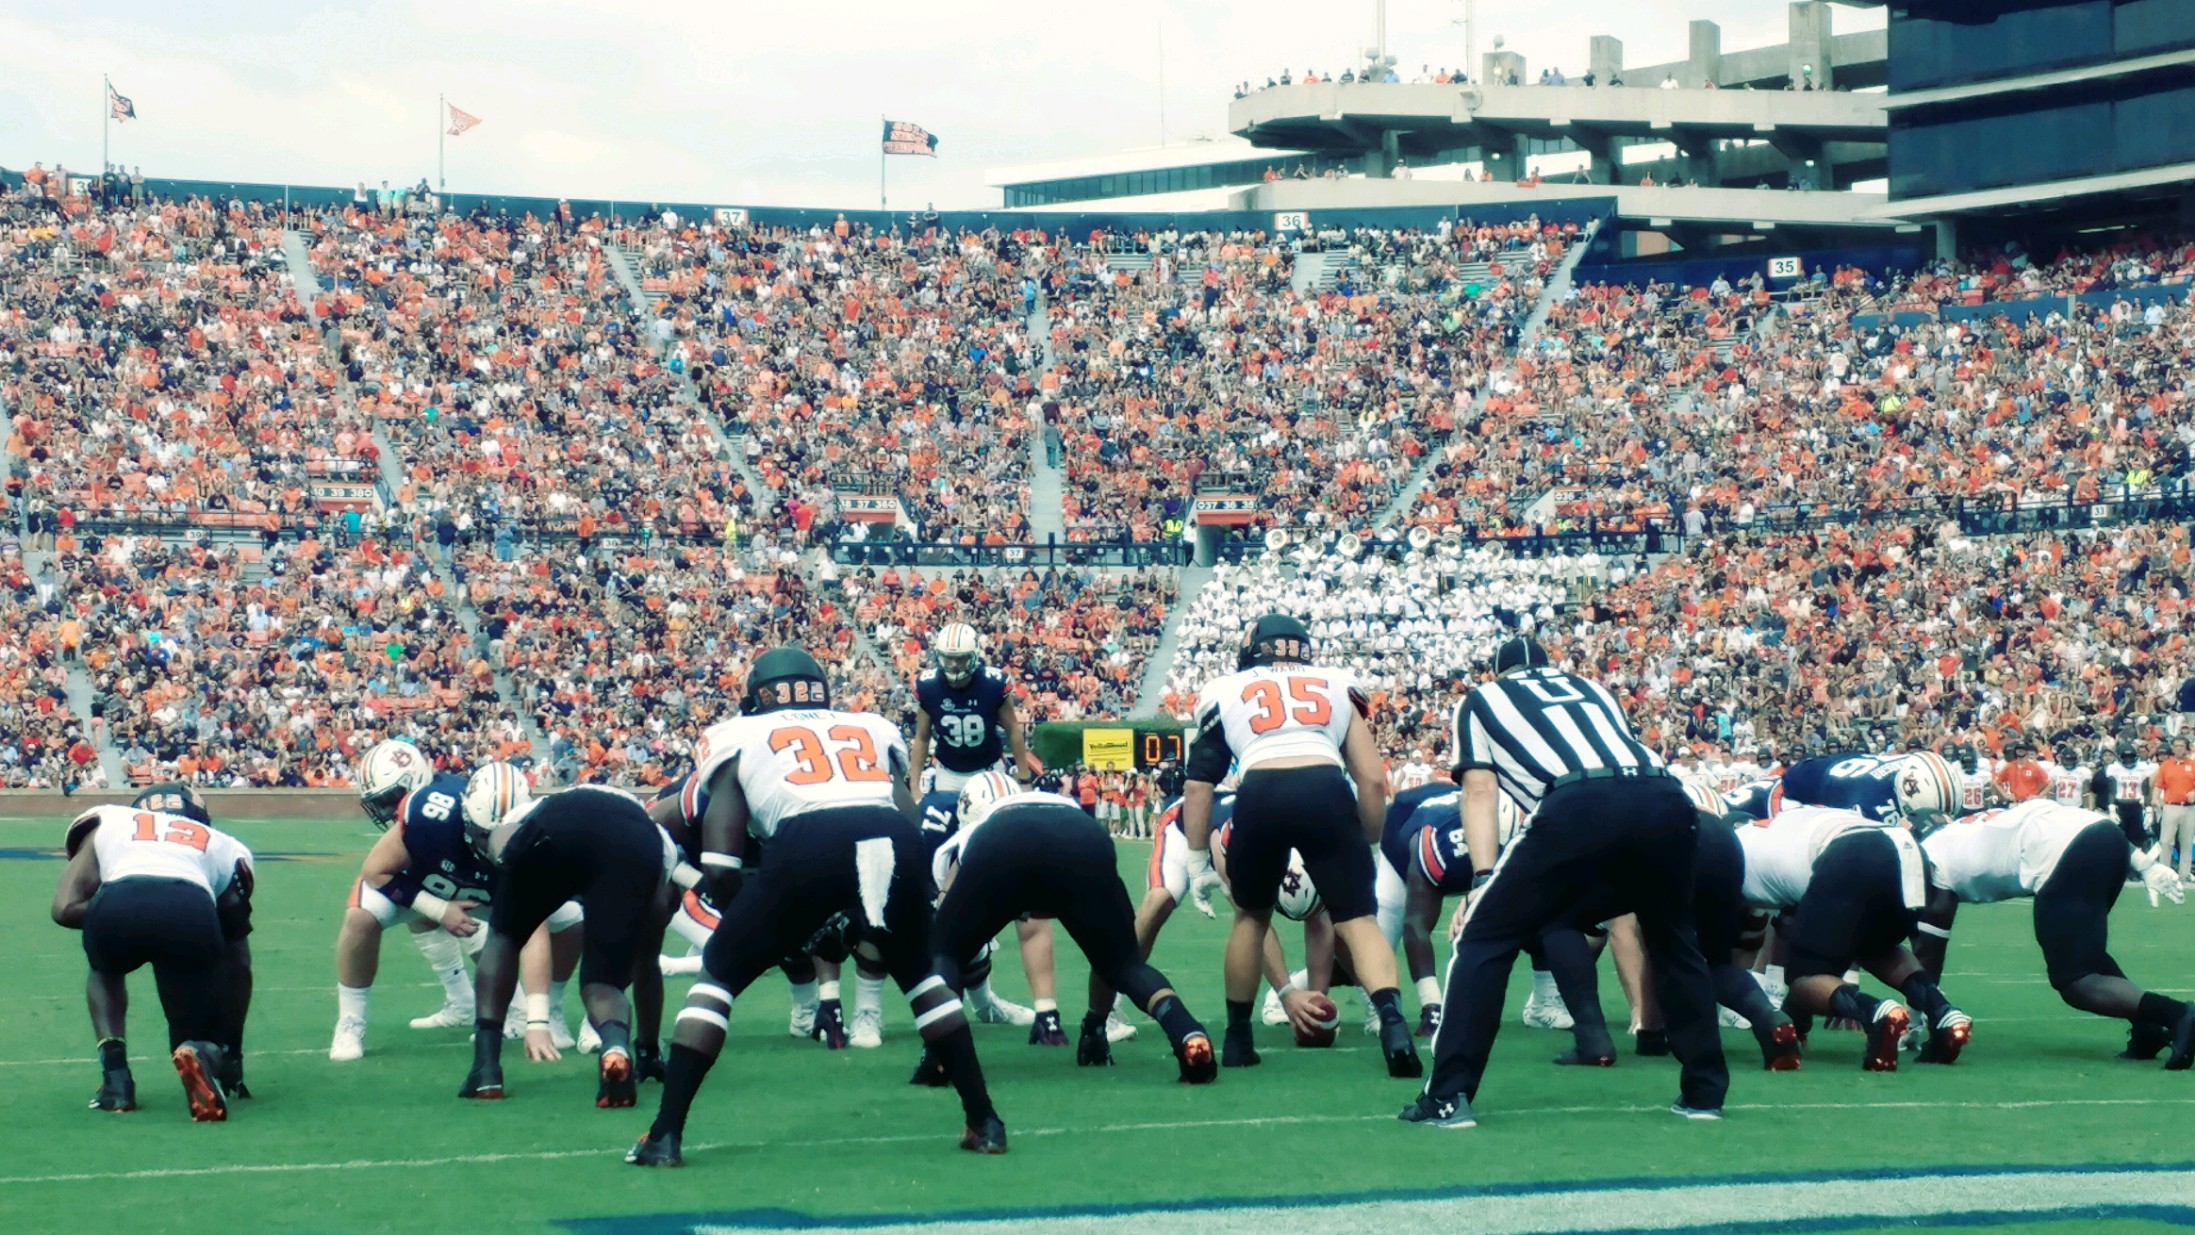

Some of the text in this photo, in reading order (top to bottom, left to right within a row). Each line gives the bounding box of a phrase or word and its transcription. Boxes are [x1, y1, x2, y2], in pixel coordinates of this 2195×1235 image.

[722, 211, 741, 225] 37
[1282, 215, 1301, 227] 36
[1775, 260, 1794, 274] 35
[1009, 549, 1021, 557] 37
[1275, 639, 1300, 657] 35
[776, 680, 809, 705] 32
[1240, 675, 1333, 736] 35
[941, 714, 985, 748] 38
[767, 724, 893, 786] 32
[1145, 734, 1182, 763] 07
[1964, 788, 1982, 805] 26
[2057, 780, 2077, 799] 27
[2121, 781, 2139, 799] 13
[421, 791, 456, 821] 98
[922, 805, 953, 833] 71
